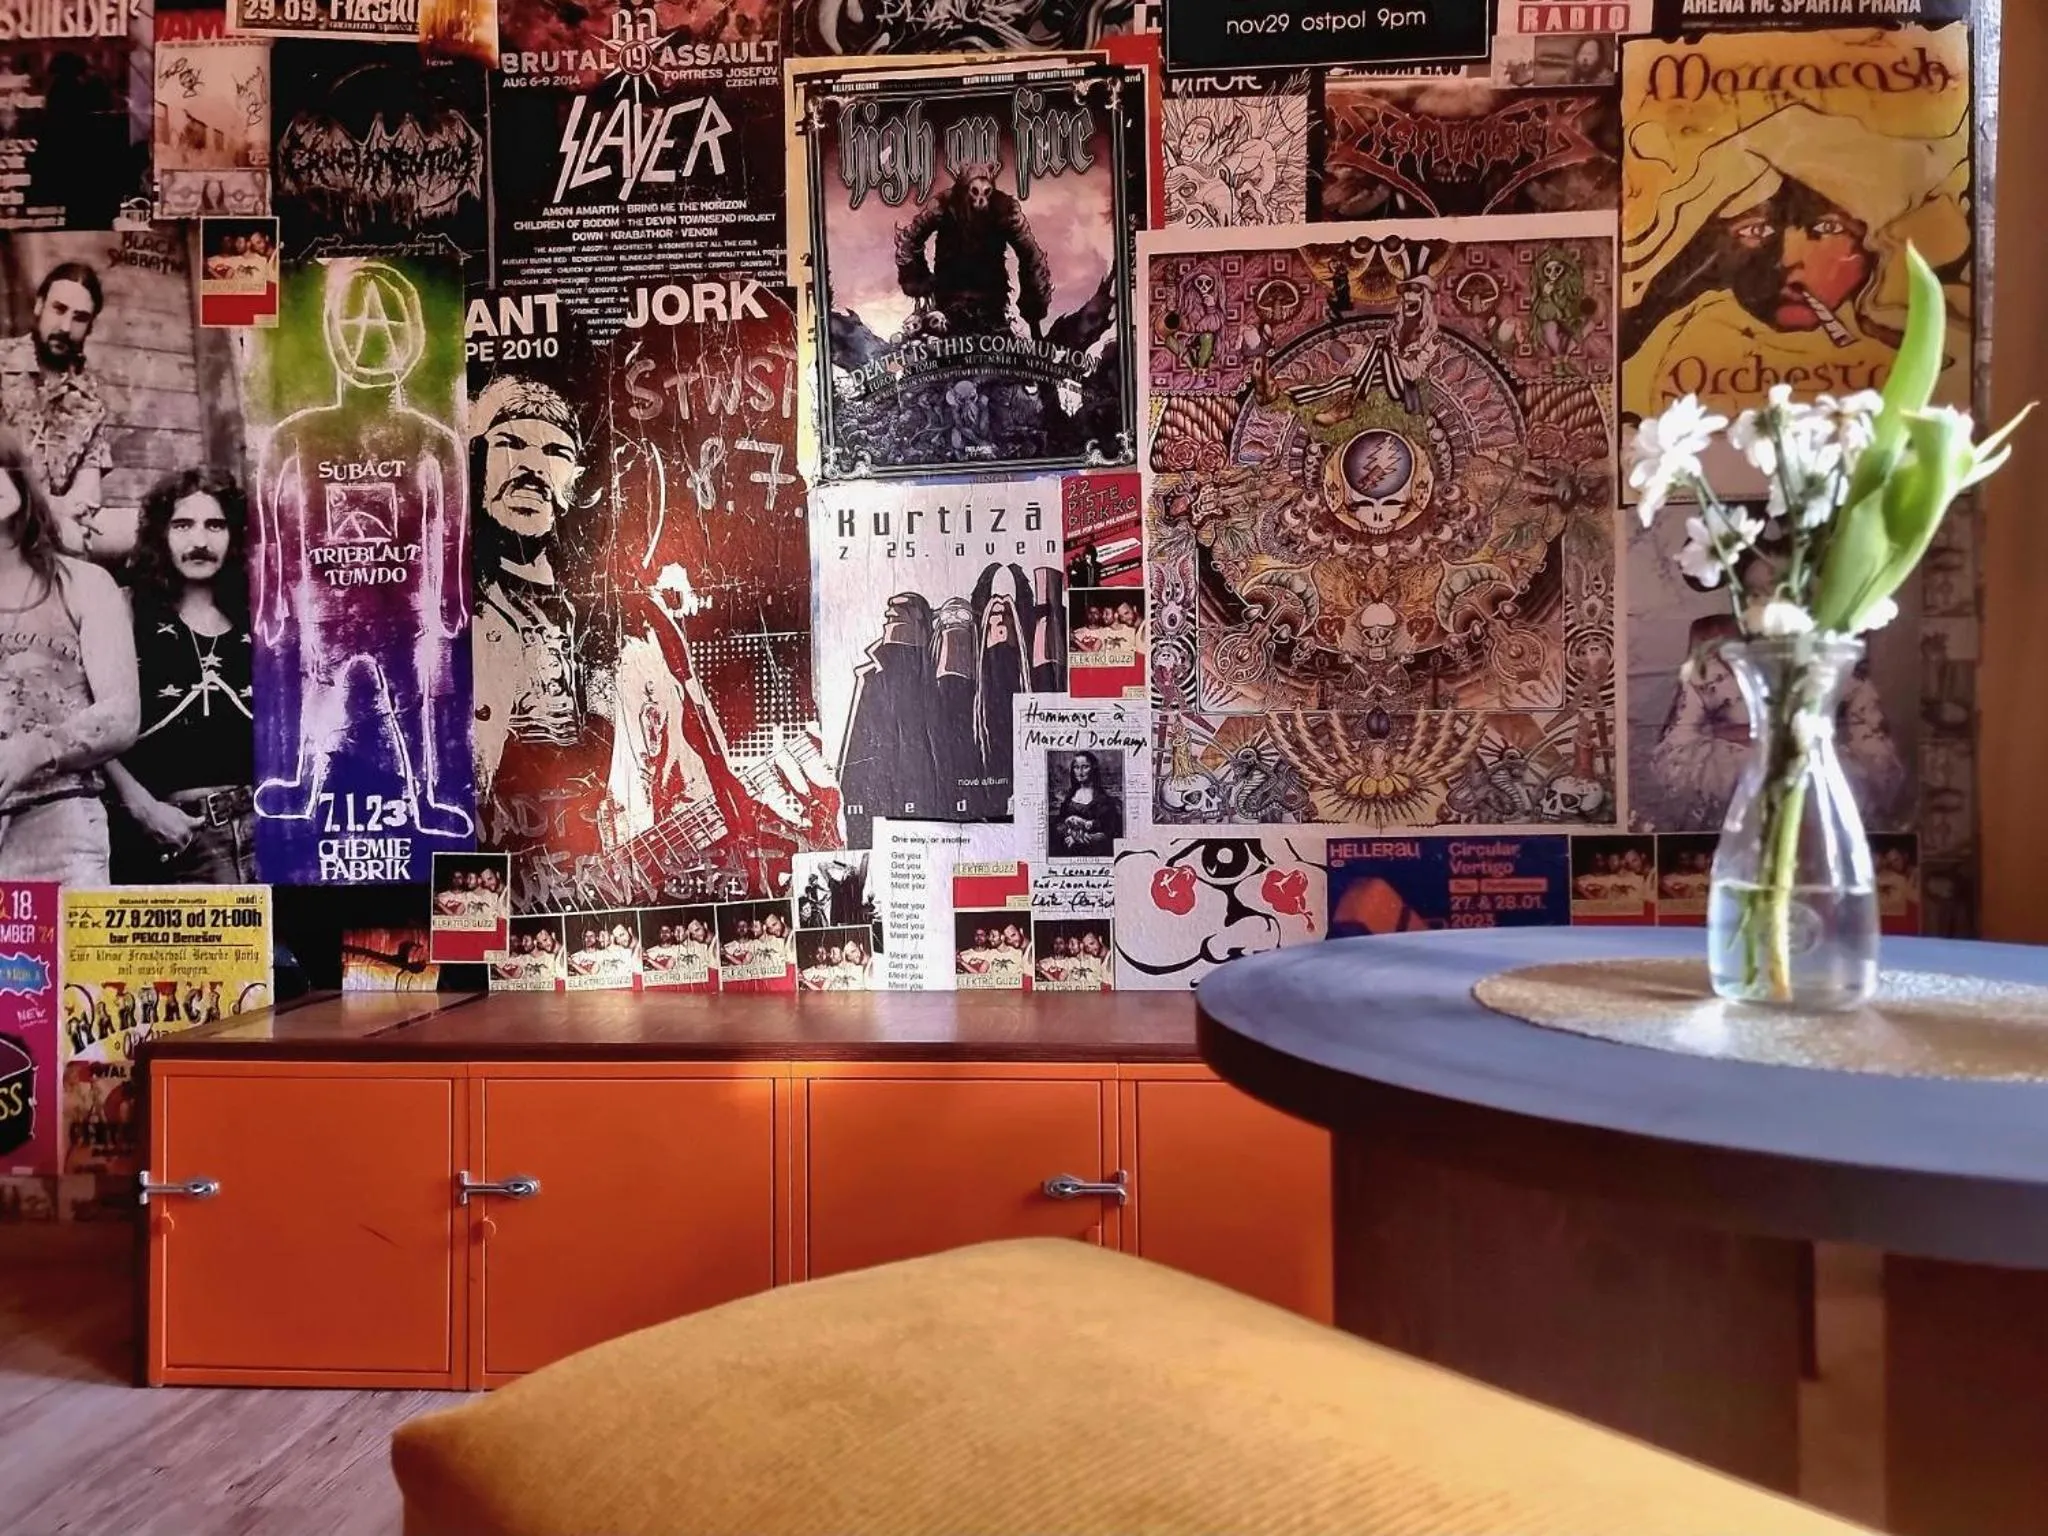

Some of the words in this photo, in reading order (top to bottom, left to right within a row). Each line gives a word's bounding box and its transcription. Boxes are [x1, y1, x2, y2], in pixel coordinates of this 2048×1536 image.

[1227, 14, 1290, 36] nov29
[1301, 11, 1367, 34] ostpol
[1377, 9, 1426, 34] 9pm
[1521, 7, 1627, 32] RADIO
[500, 49, 617, 74] BRUTAL
[659, 40, 778, 67] ASSAULT
[503, 78, 528, 89] AUG
[530, 77, 550, 87] 6-9
[553, 76, 581, 87] 2014
[664, 68, 723, 81] FORTRESS
[726, 66, 778, 78] JOSEFOV
[725, 78, 757, 88] CZECH
[553, 95, 733, 204] SLAYER
[542, 206, 573, 217] AMON
[576, 205, 620, 216] AMARTH
[627, 203, 659, 214] BRING
[660, 202, 676, 212] ME
[679, 201, 700, 212] THE
[700, 200, 747, 211] HORIZON
[513, 220, 565, 231] CHILDREN
[566, 219, 580, 229] OF
[583, 218, 620, 228] BODOM
[645, 216, 677, 226] DEVIN
[680, 214, 737, 225] TOWNSEND
[738, 213, 776, 222] PROJECT
[572, 231, 603, 241] DOWN
[611, 229, 674, 240] KRABATHOR
[681, 227, 719, 238] VENOM
[624, 281, 769, 331] JORK
[503, 337, 559, 360] 2010
[851, 349, 907, 388] DEATH
[911, 343, 929, 363] IS
[934, 335, 974, 357] THIS
[979, 335, 1103, 373] COMMUNION
[1669, 353, 1892, 395] Orchestr
[318, 460, 406, 480] SUBACT
[309, 543, 423, 566] TRIEBLAUT
[1025, 730, 1080, 750] Marcel
[981, 776, 1009, 786] album
[319, 793, 408, 833] 7.1.23
[318, 838, 412, 860] CHEMIE
[1448, 842, 1521, 857] Circular
[319, 860, 411, 881] FABRIK
[1449, 860, 1515, 878] Vertigo
[186, 908, 206, 928] od
[109, 932, 130, 944] bar
[132, 932, 170, 944] PEKLO
